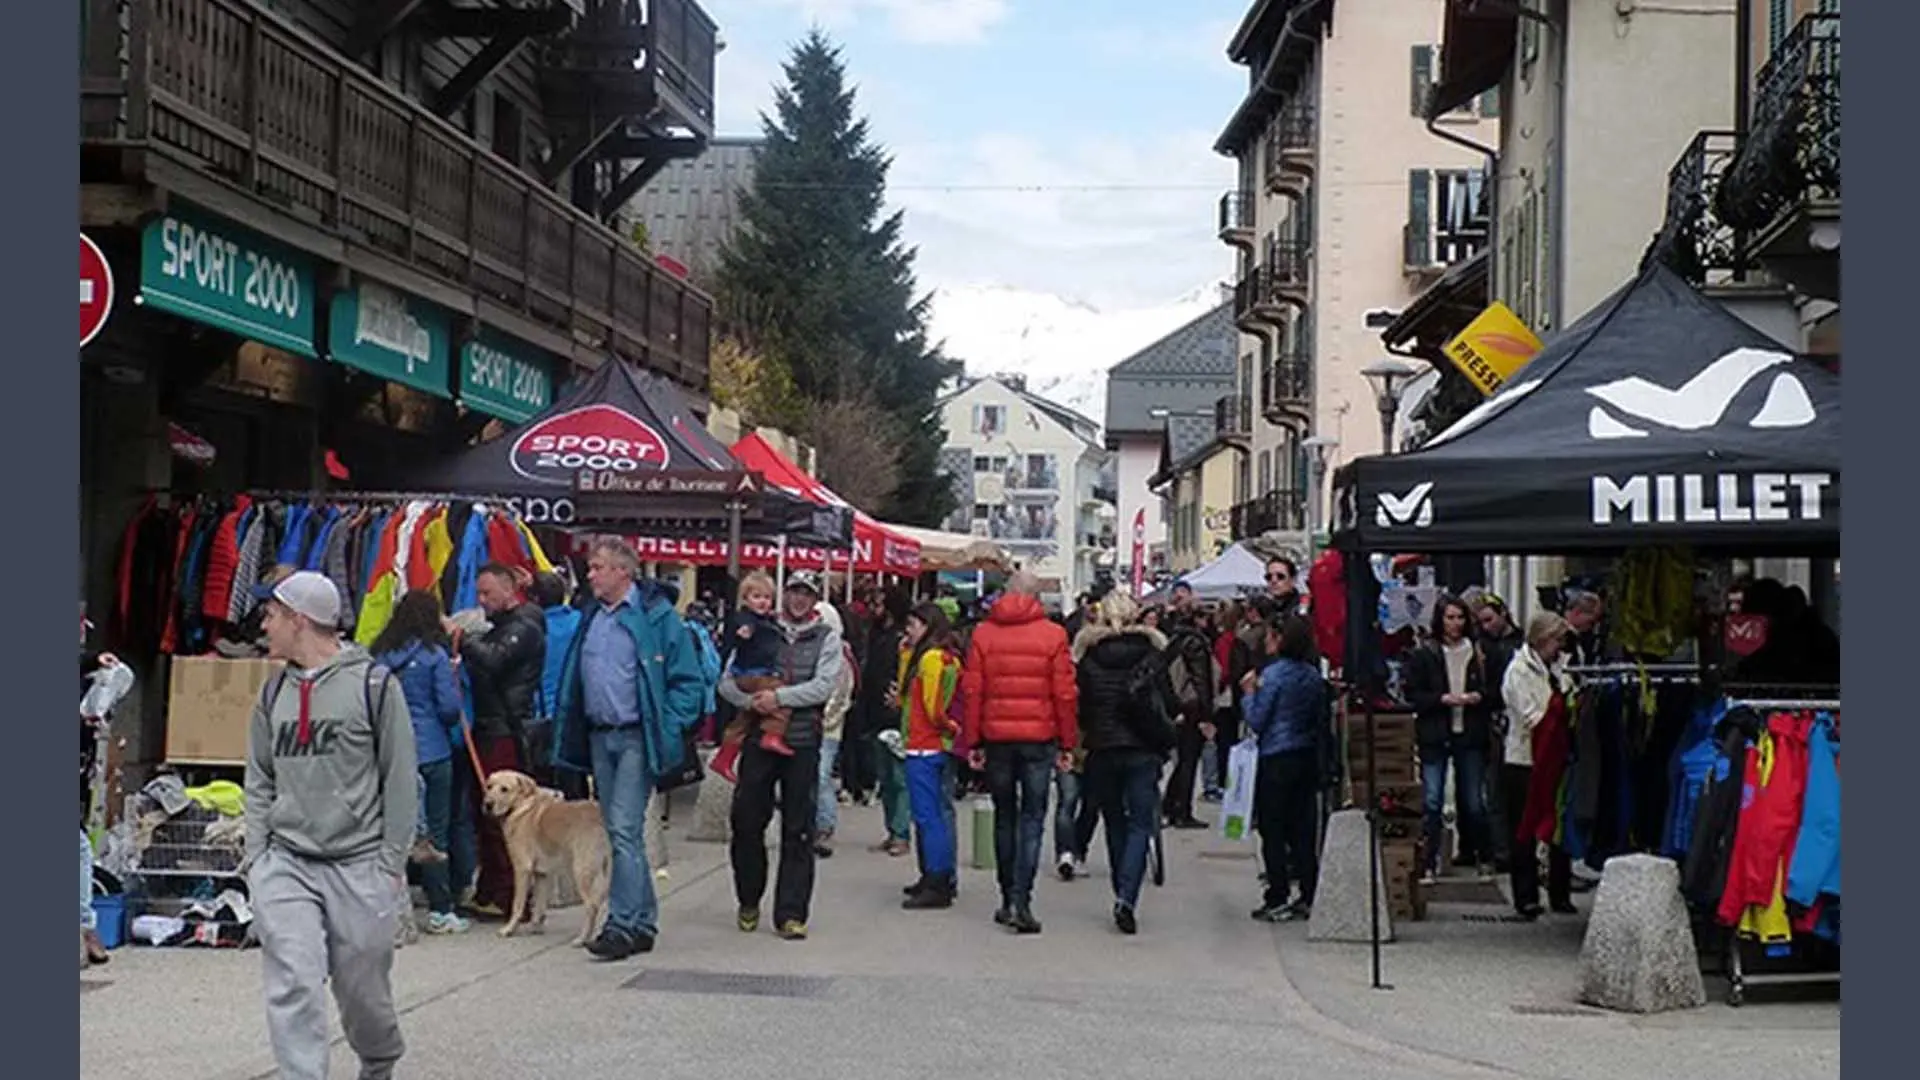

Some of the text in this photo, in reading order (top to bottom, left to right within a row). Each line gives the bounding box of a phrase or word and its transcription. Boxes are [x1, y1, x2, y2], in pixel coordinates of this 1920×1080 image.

[162, 217, 299, 319] SPORT 2000
[469, 342, 544, 406] SPORT 2000
[530, 435, 656, 459] SPORT
[535, 451, 638, 471] 2000
[1592, 473, 1831, 523] MILLET
